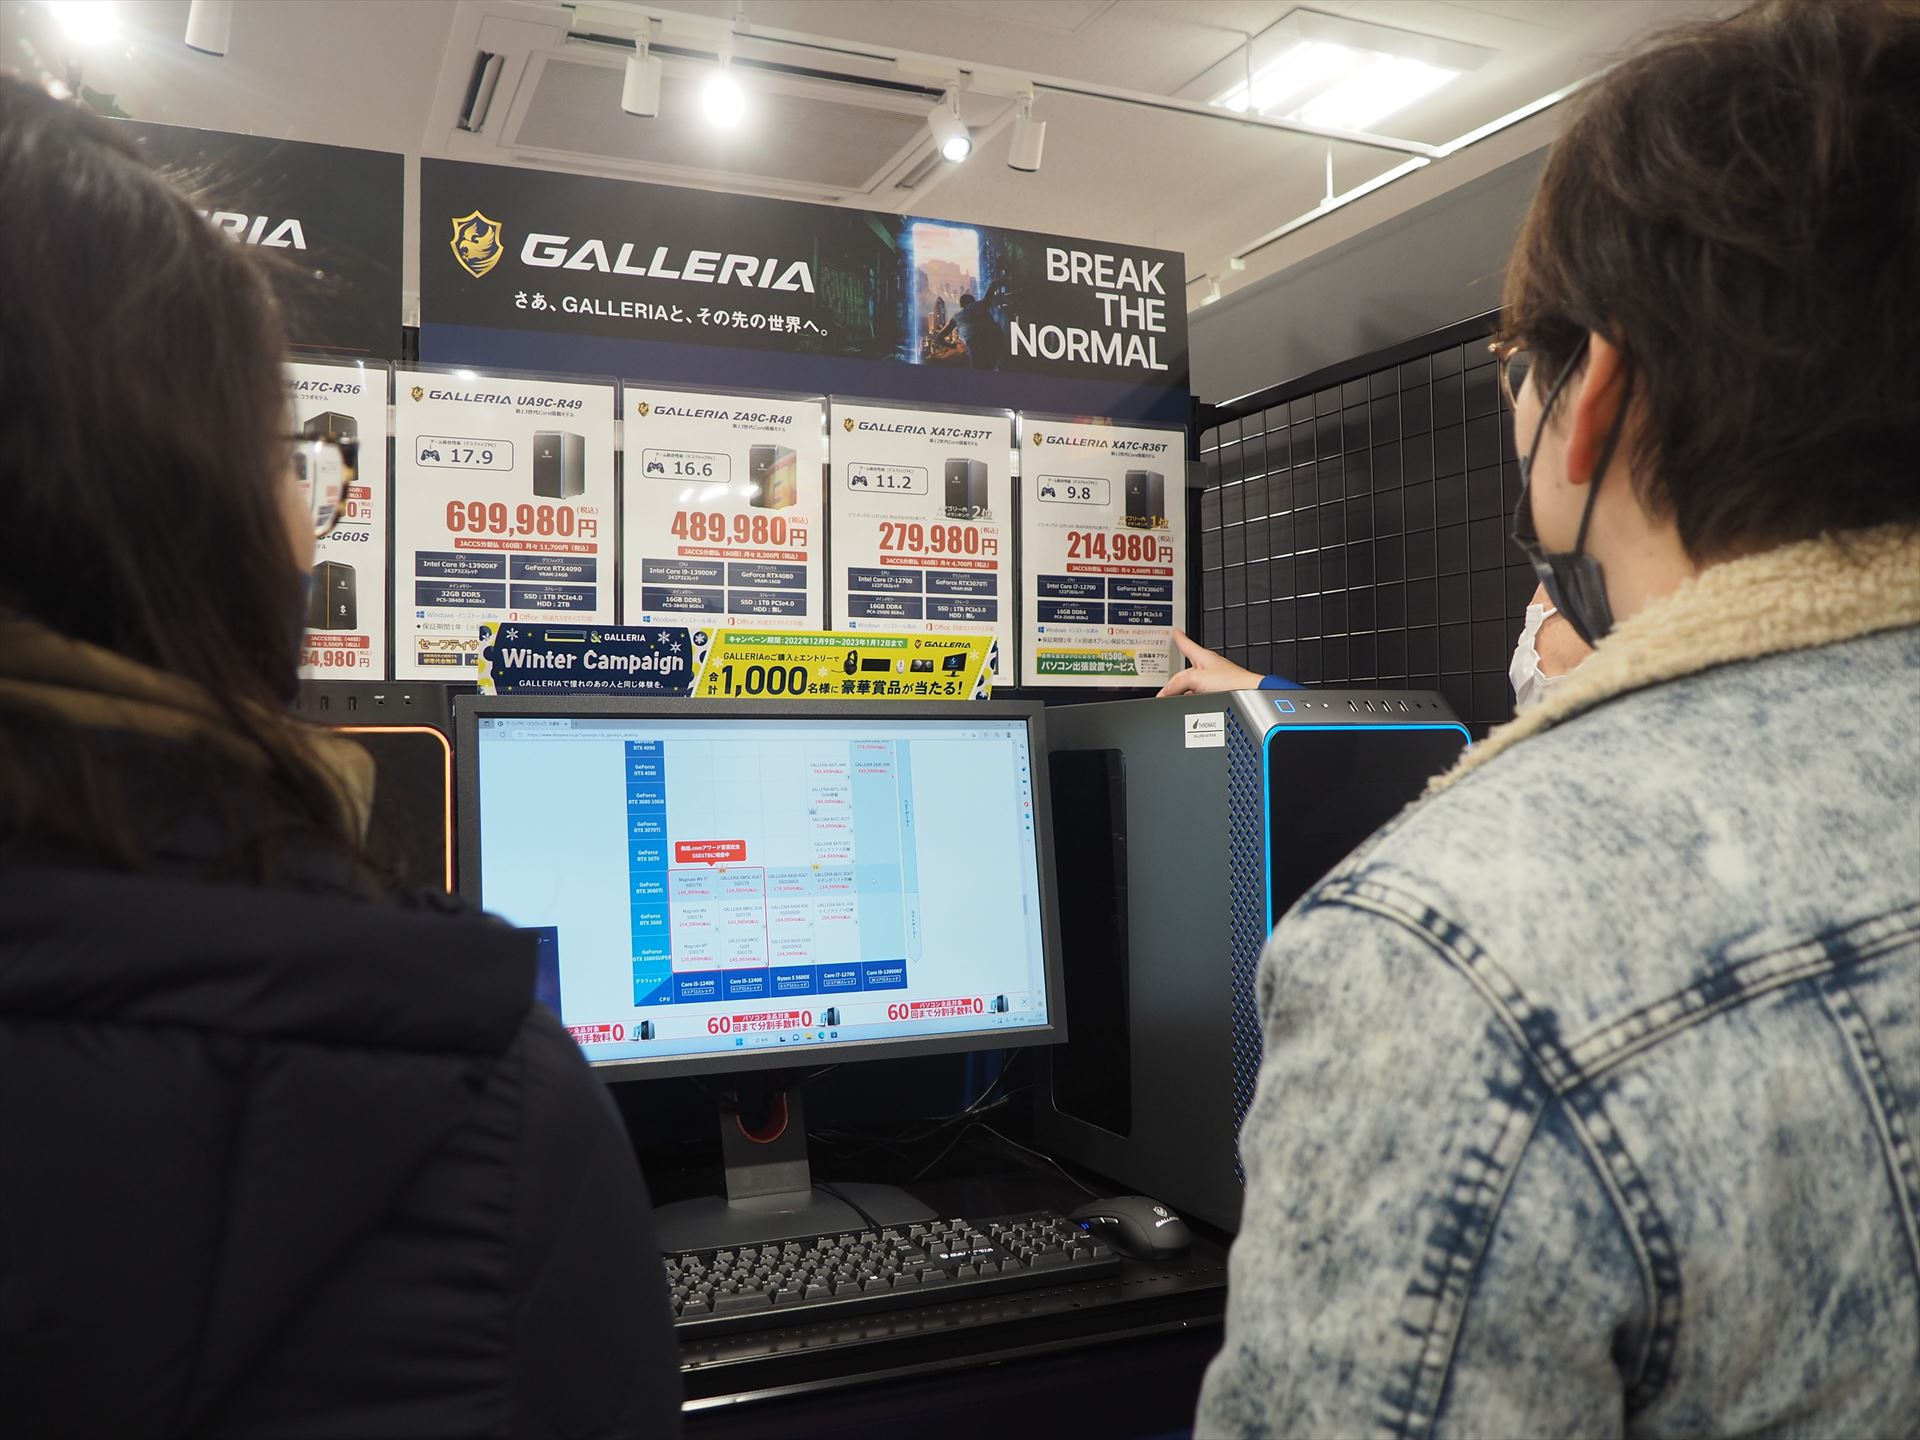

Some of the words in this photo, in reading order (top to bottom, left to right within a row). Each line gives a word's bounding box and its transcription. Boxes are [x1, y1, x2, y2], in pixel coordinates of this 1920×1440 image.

[198, 210, 307, 250] RIA
[520, 233, 815, 293] GALLERIA
[1046, 247, 1166, 295] BREAK
[514, 290, 829, 337] さあ、GALLERIAと、その先の世界へ。
[1095, 292, 1167, 333] THE
[1010, 321, 1169, 371] NORMAL
[429, 390, 512, 405] GALLERIA
[517, 396, 583, 411] UA9C-R49
[653, 405, 729, 420] GALLERIA
[732, 411, 793, 425] ZA9C-R48
[858, 421, 927, 435] GALLERIA
[930, 427, 993, 440] XA7C-R37T
[1046, 435, 1108, 448] GALLERIA
[1111, 440, 1168, 453] XA7C-R36T
[451, 448, 493, 464] 17.9
[674, 461, 713, 477] 16.6
[876, 475, 912, 490] 11.2
[1067, 486, 1091, 500] 9.8
[525, 564, 551, 572] GeForce
[553, 565, 582, 573] RTX4090
[649, 567, 665, 575] Intel
[741, 571, 766, 579] GeForce
[936, 579, 958, 587] GeForce
[590, 630, 602, 643] &
[604, 633, 646, 642] GALLERIA
[924, 640, 971, 649] GALLERIA
[501, 648, 578, 670] Winter
[583, 649, 684, 675] Campaign
[723, 652, 840, 662] GALLERIAのご購入とエントリーで
[1040, 661, 1136, 673] パソコン出張設置サービス
[887, 1003, 909, 1021] 60
[973, 997, 984, 1014] 0
[707, 1016, 731, 1036] 60
[801, 1010, 813, 1028] 0
[612, 1023, 625, 1041] 0
